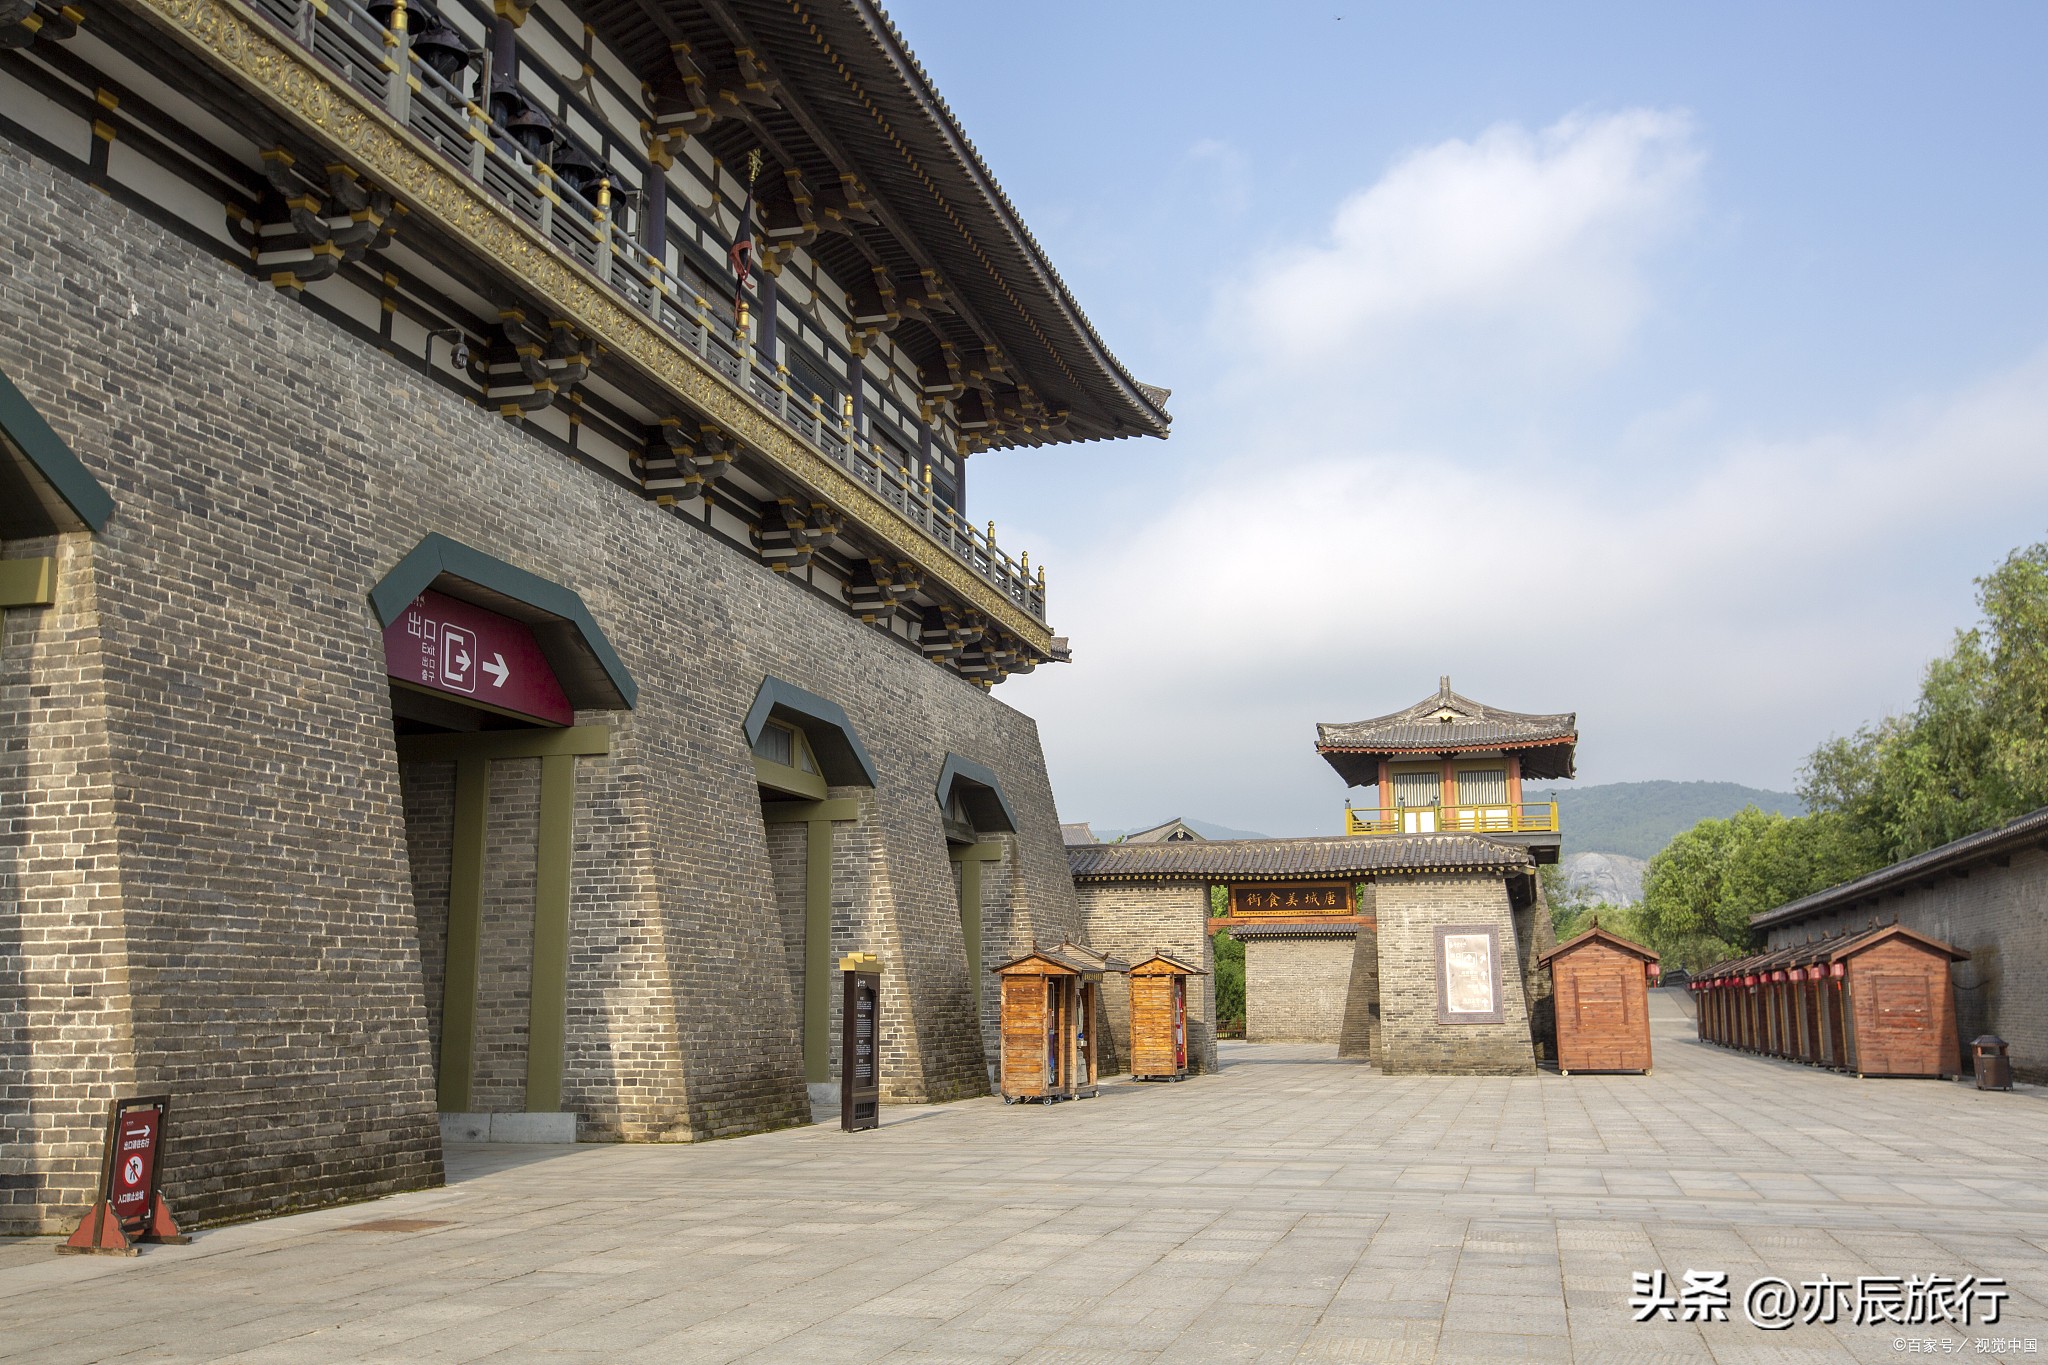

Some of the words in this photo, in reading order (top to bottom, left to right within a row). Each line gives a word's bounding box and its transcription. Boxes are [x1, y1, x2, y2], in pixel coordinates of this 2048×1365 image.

[407, 611, 436, 642] 出口
[421, 642, 435, 656] Exit
[421, 656, 435, 669] 出口
